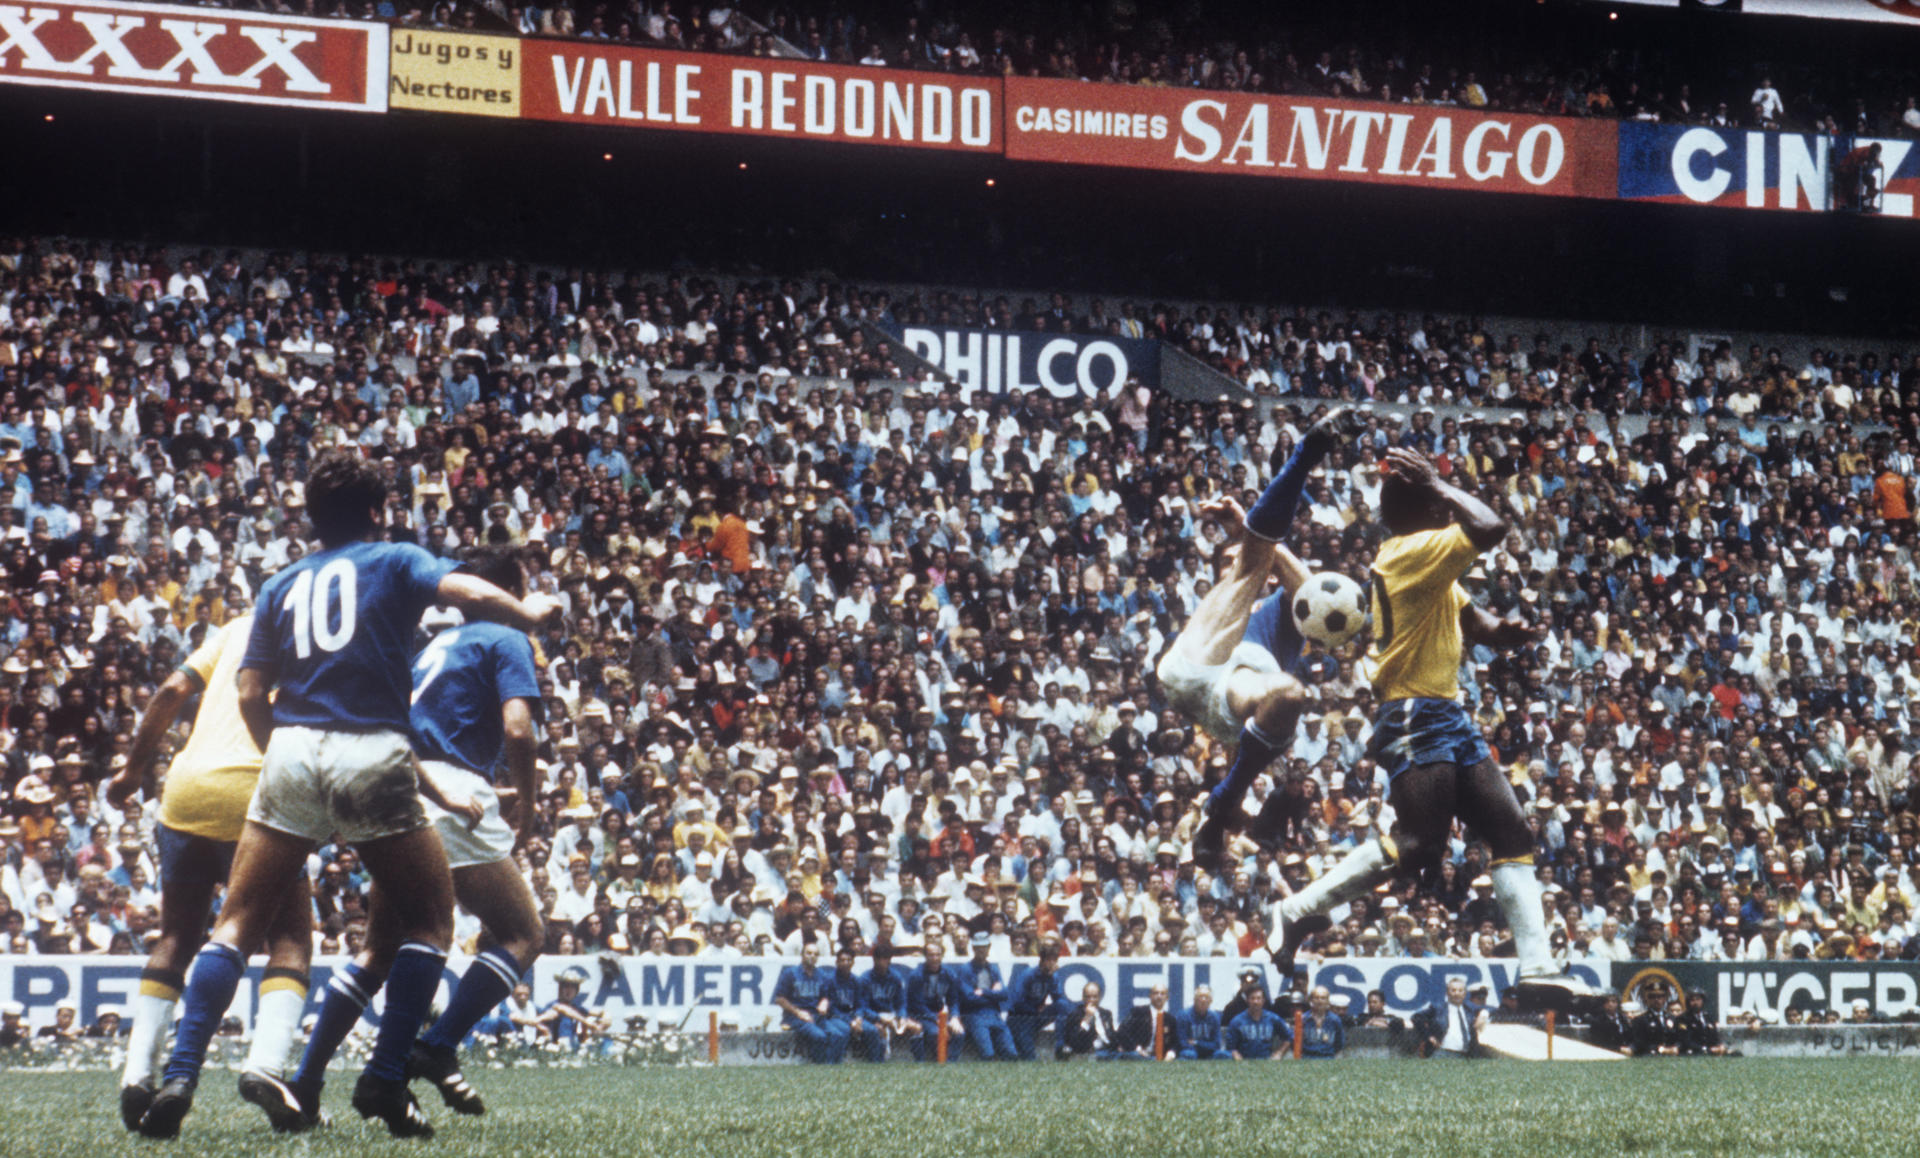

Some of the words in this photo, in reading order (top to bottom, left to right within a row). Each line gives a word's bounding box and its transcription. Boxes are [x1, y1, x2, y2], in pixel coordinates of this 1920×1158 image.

[391, 74, 513, 104] Nectares
[395, 34, 488, 64] Jugos
[498, 48, 513, 70] y
[551, 54, 701, 124] VALLE
[731, 68, 991, 147] REDONDO
[1016, 105, 1168, 140] CASIMIRES
[1173, 98, 1565, 186] SANTIAGO
[904, 328, 1129, 401] PHILCO
[282, 557, 357, 660] 10
